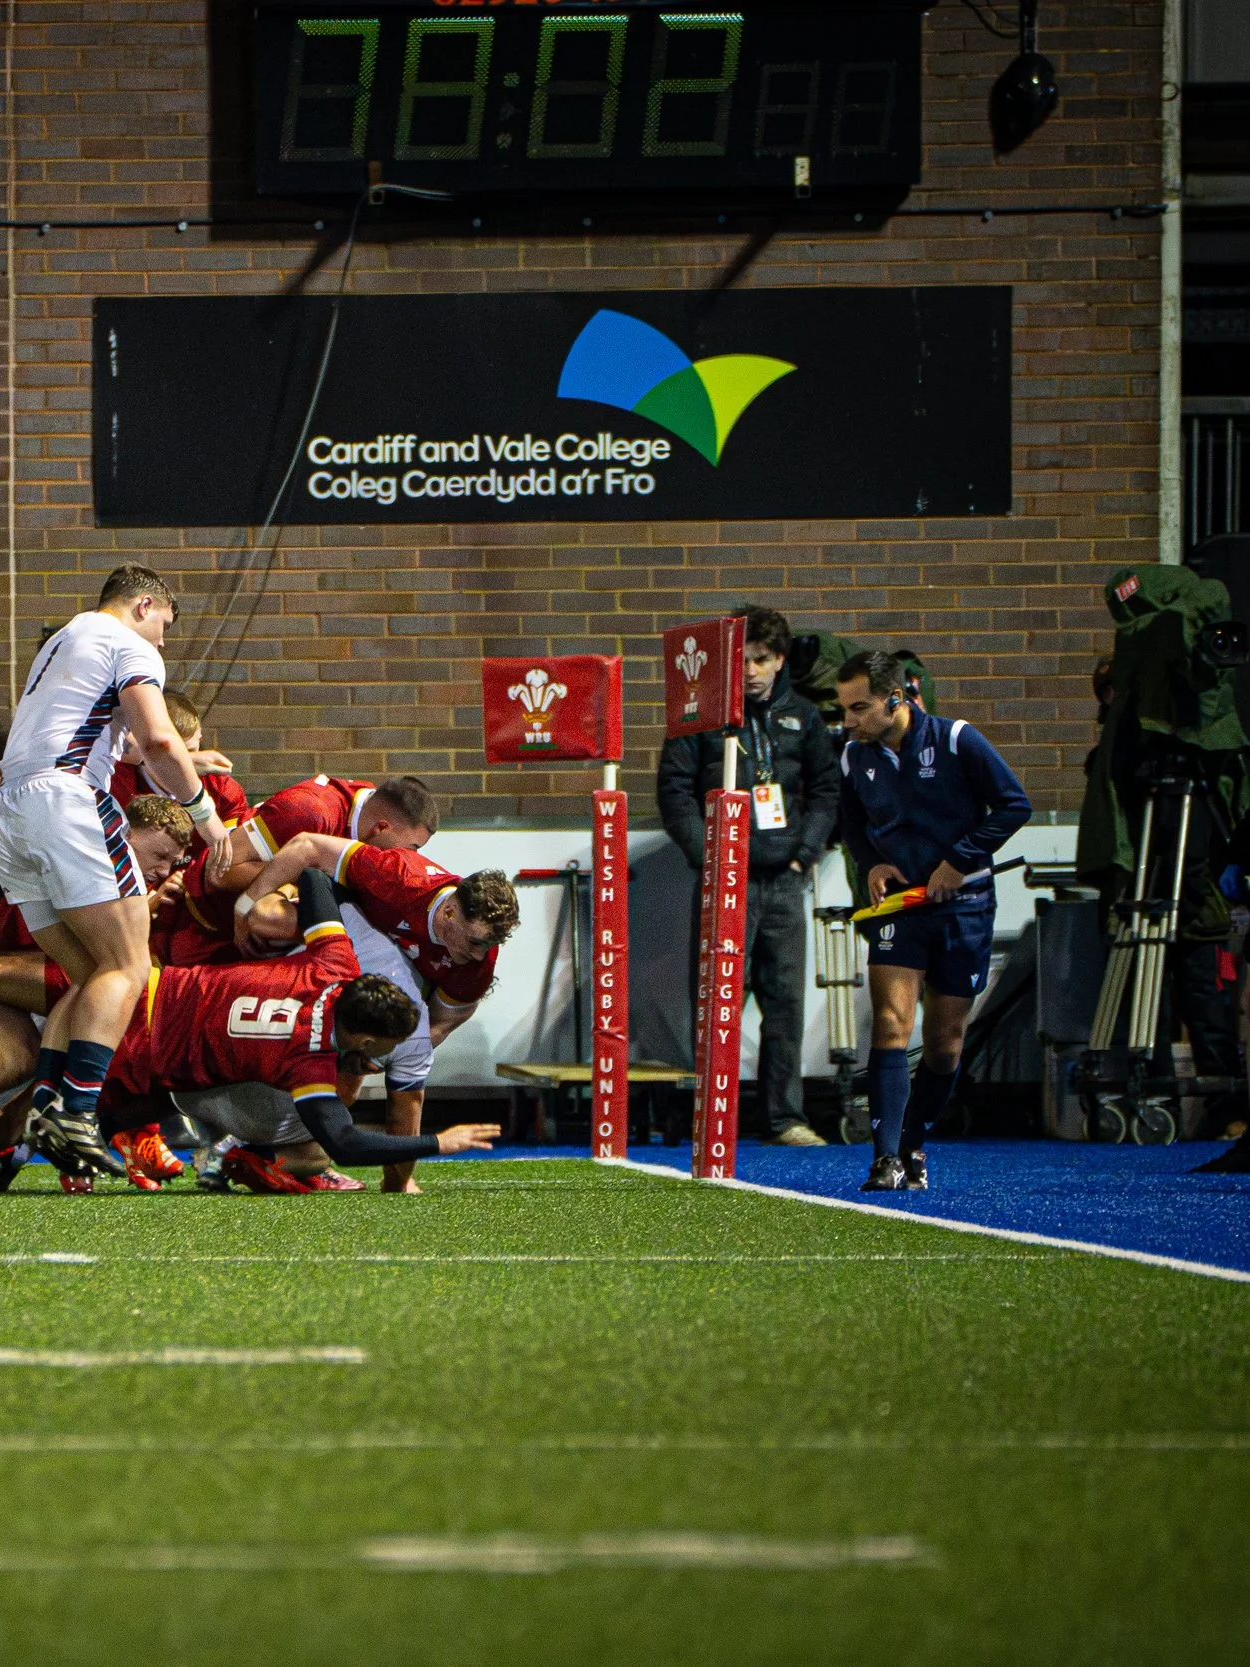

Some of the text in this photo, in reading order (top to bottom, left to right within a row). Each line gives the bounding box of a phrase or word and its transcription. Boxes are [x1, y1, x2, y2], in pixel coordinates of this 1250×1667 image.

[308, 432, 671, 467] Cardiff and Vale College
[308, 469, 398, 505] Coleg
[402, 468, 557, 503] Caerdydd
[605, 468, 655, 495] Fro
[598, 801, 617, 1158] WELSH RUGBY UNION
[710, 803, 743, 1179] WELSH RUGBY UNION
